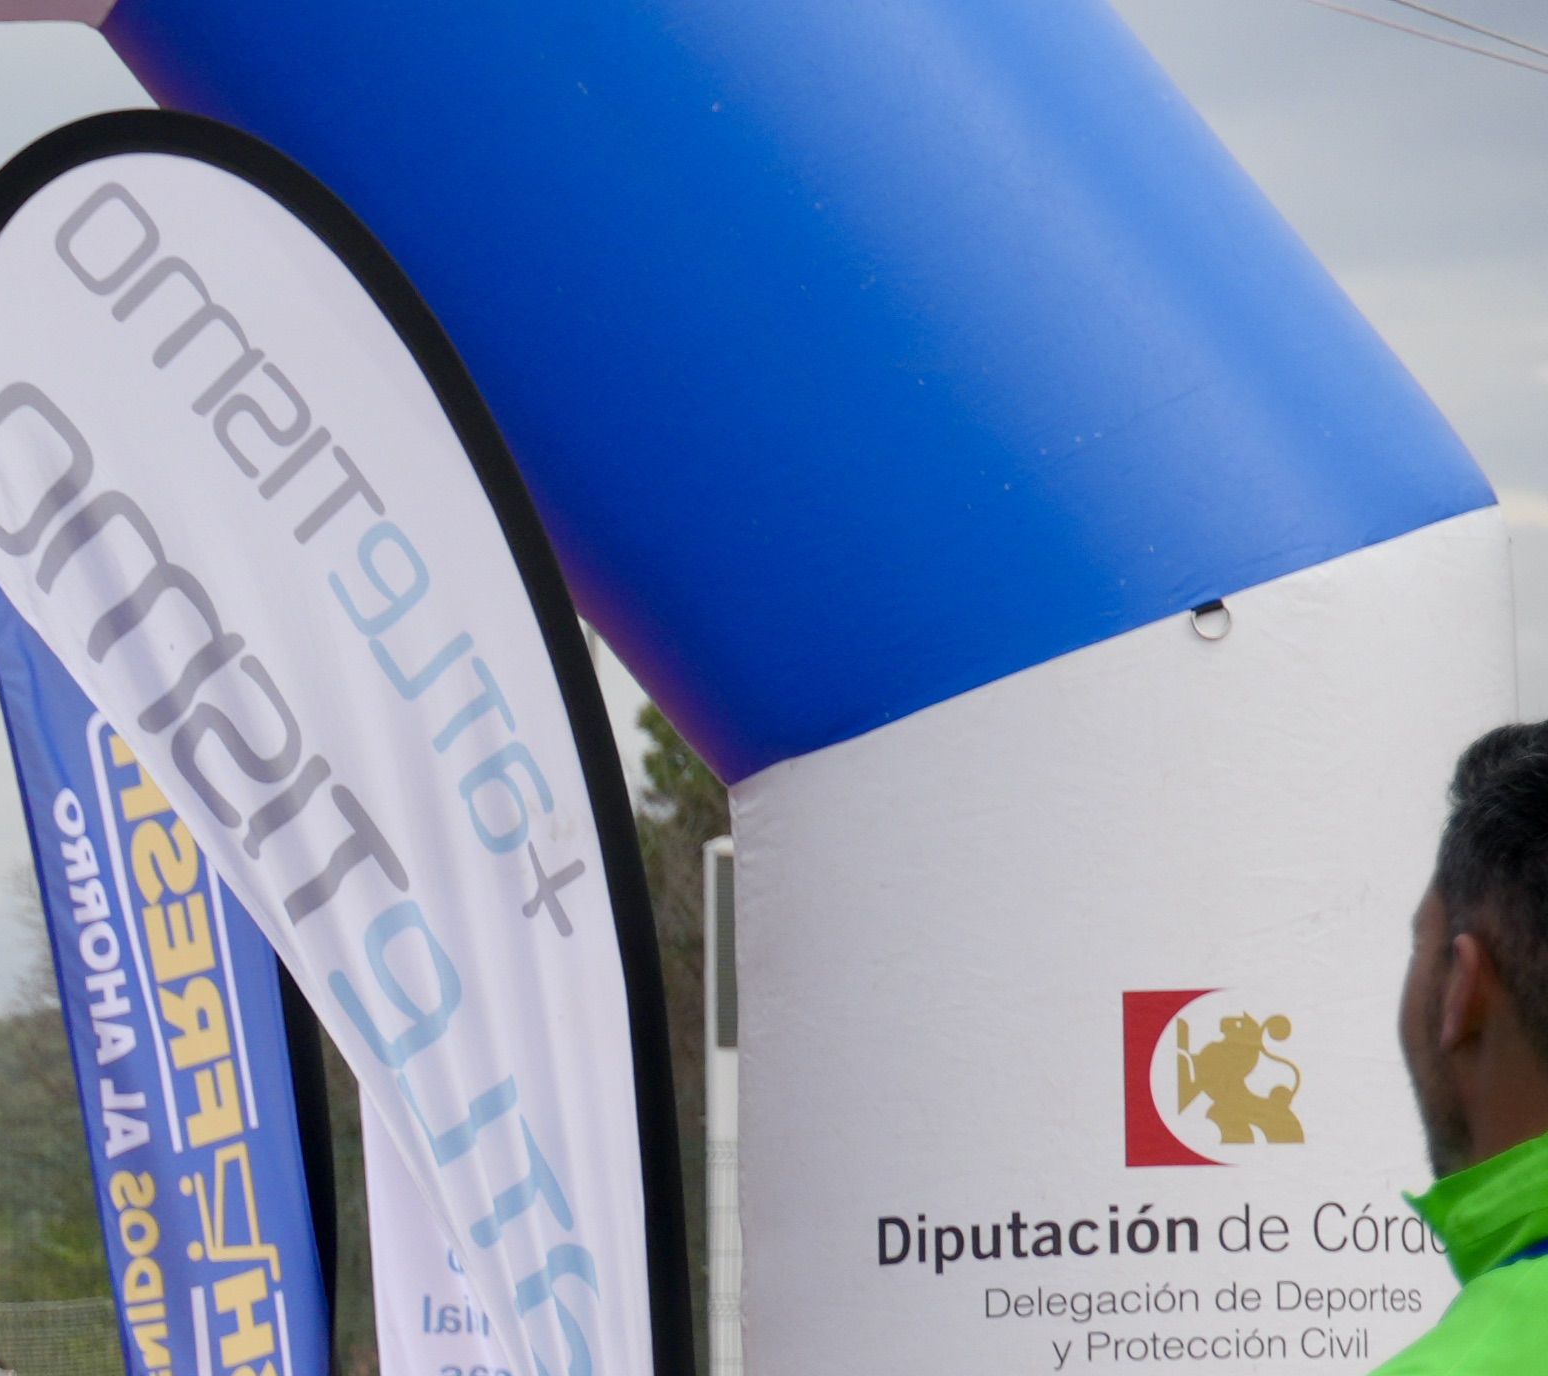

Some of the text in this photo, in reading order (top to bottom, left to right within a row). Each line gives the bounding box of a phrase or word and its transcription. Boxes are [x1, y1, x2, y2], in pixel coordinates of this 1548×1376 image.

[876, 1205, 1200, 1274] Diputación
[1218, 1203, 1290, 1254] de
[983, 1281, 1423, 1323] Delegación de Deportes
[1052, 1327, 1370, 1370] y Protección Civil
